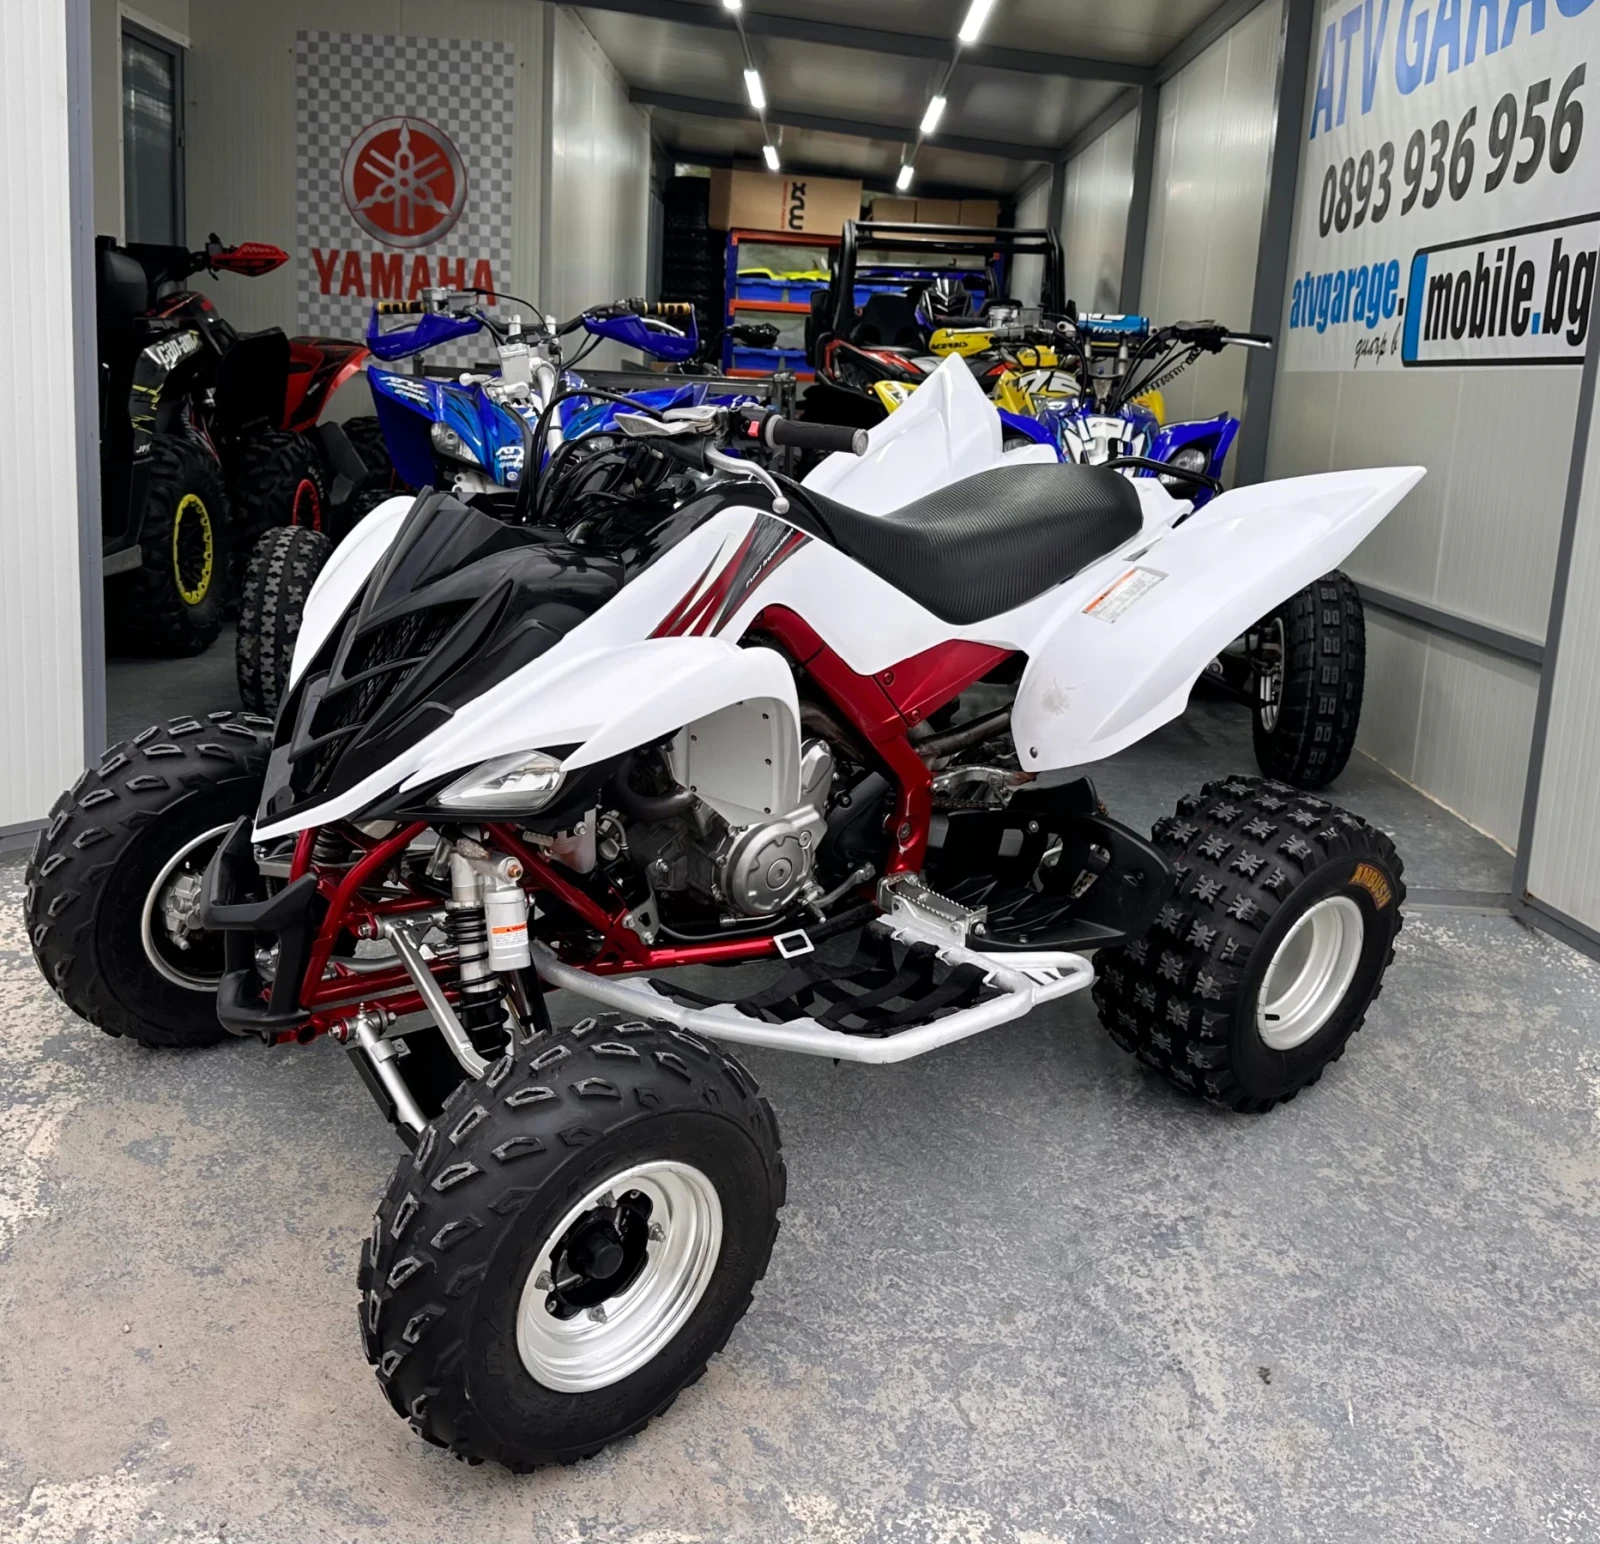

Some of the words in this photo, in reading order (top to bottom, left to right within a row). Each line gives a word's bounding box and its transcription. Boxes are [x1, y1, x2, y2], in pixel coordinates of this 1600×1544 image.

[1309, 0, 1391, 140] ATV
[1319, 141, 1395, 238] 0893
[1400, 106, 1477, 217] 936
[1484, 62, 1587, 194] 956
[311, 247, 497, 307] YAMAHA
[1423, 237, 1597, 347] mobile.bg
[1350, 864, 1391, 909] AMBUSH
